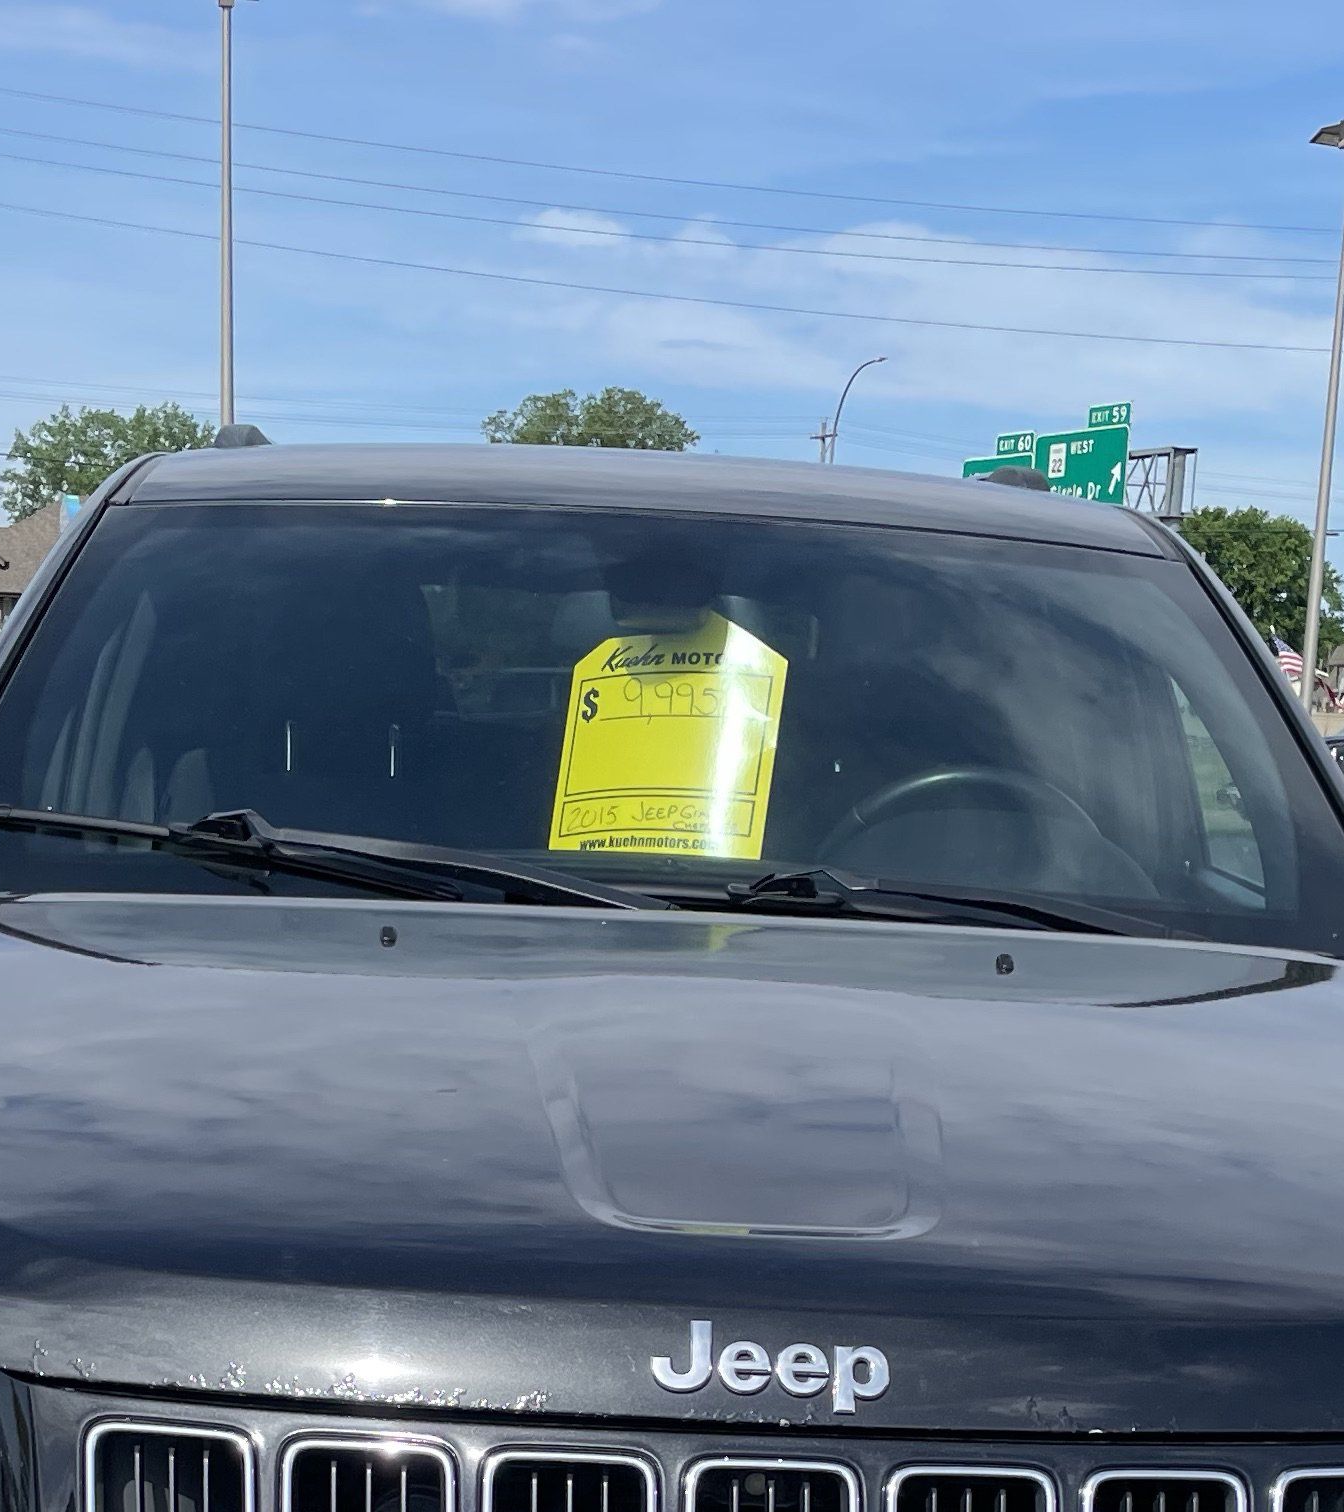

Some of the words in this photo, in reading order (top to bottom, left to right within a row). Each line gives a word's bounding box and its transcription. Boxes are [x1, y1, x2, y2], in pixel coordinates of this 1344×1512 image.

[1091, 410, 1110, 424] EXIT
[1112, 405, 1127, 423] 59
[999, 439, 1015, 452] EXIT
[1017, 435, 1032, 451] 60
[1070, 439, 1095, 455] WEST
[1051, 458, 1063, 473] 22
[1087, 481, 1102, 500] Dr
[601, 644, 666, 673] Kuehn
[671, 651, 725, 666] MOTO
[581, 687, 601, 723] $
[567, 804, 619, 833] 2015
[631, 801, 679, 823] JEEP
[649, 1318, 892, 1415] Jeep
